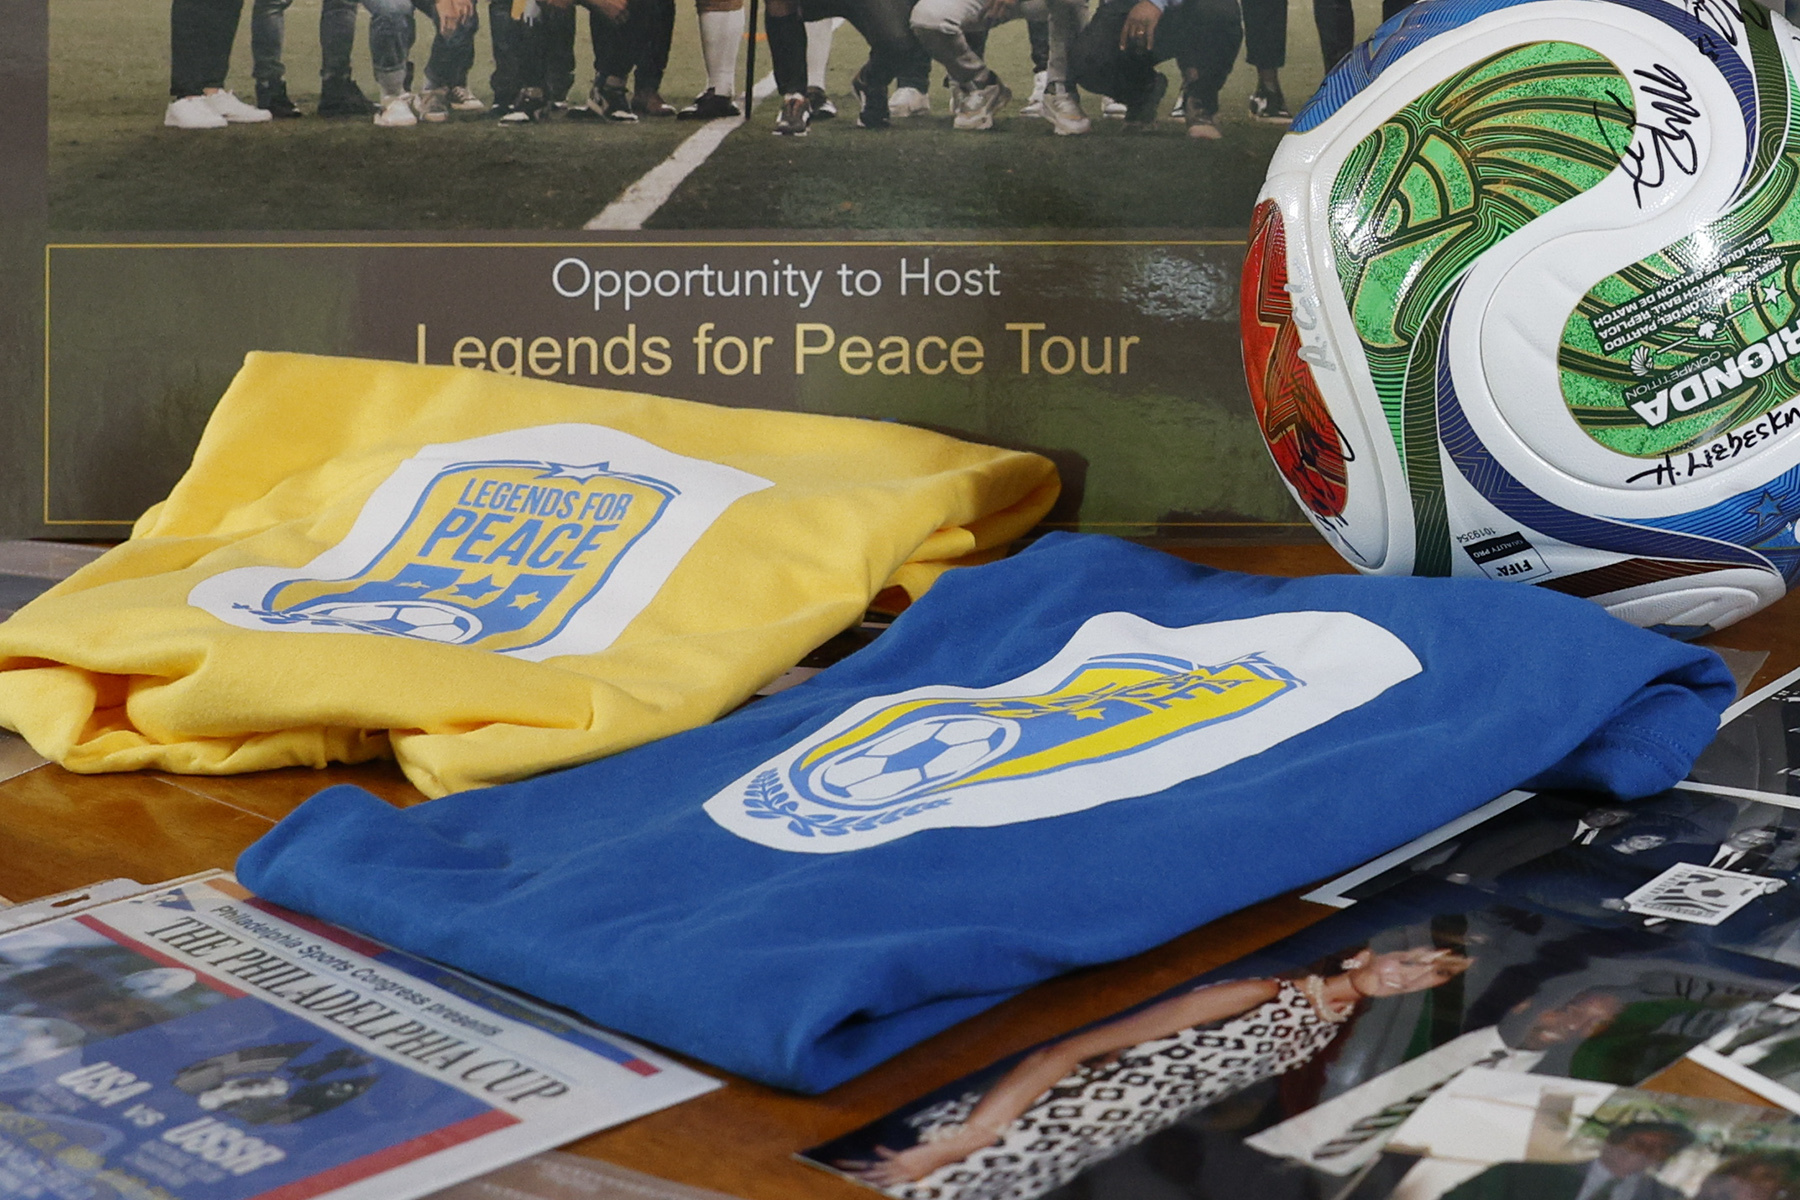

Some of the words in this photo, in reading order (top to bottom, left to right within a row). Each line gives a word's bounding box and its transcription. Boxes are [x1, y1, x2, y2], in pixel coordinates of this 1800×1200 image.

[551, 257, 823, 310] Opportunity
[838, 261, 882, 298] to
[899, 257, 1002, 298] Host
[1636, 289, 1656, 308] DE
[1656, 267, 1704, 299] BALLON
[1682, 269, 1728, 297] MATCH
[1592, 301, 1638, 329] MATCH
[1651, 289, 1682, 315] BALL
[1657, 304, 1682, 326] DEL
[1597, 307, 1652, 341] REPLICA
[1603, 315, 1660, 352] PARTIDO
[415, 322, 674, 377] Legends
[693, 322, 774, 375] for
[795, 322, 986, 376] Peace
[1005, 322, 1140, 376] Tour
[1625, 351, 1722, 401] COMPETITION
[458, 477, 581, 517] LEGENDS
[577, 490, 634, 522] FOR
[417, 508, 620, 571] PEACE
[1456, 526, 1497, 544] 1019354
[1492, 540, 1524, 553] QUALITY
[1473, 547, 1491, 558] PRO
[1496, 559, 1534, 577] FIFA
[209, 904, 304, 950] Philadelphia
[299, 944, 354, 973] Sports
[349, 966, 432, 1006] Congress
[421, 1002, 504, 1037] presents
[144, 915, 244, 959] THE
[207, 947, 481, 1071] PHILADELPHIA
[460, 1058, 570, 1103] CUP
[55, 1060, 154, 1108] USA
[161, 1114, 288, 1177] USSR
